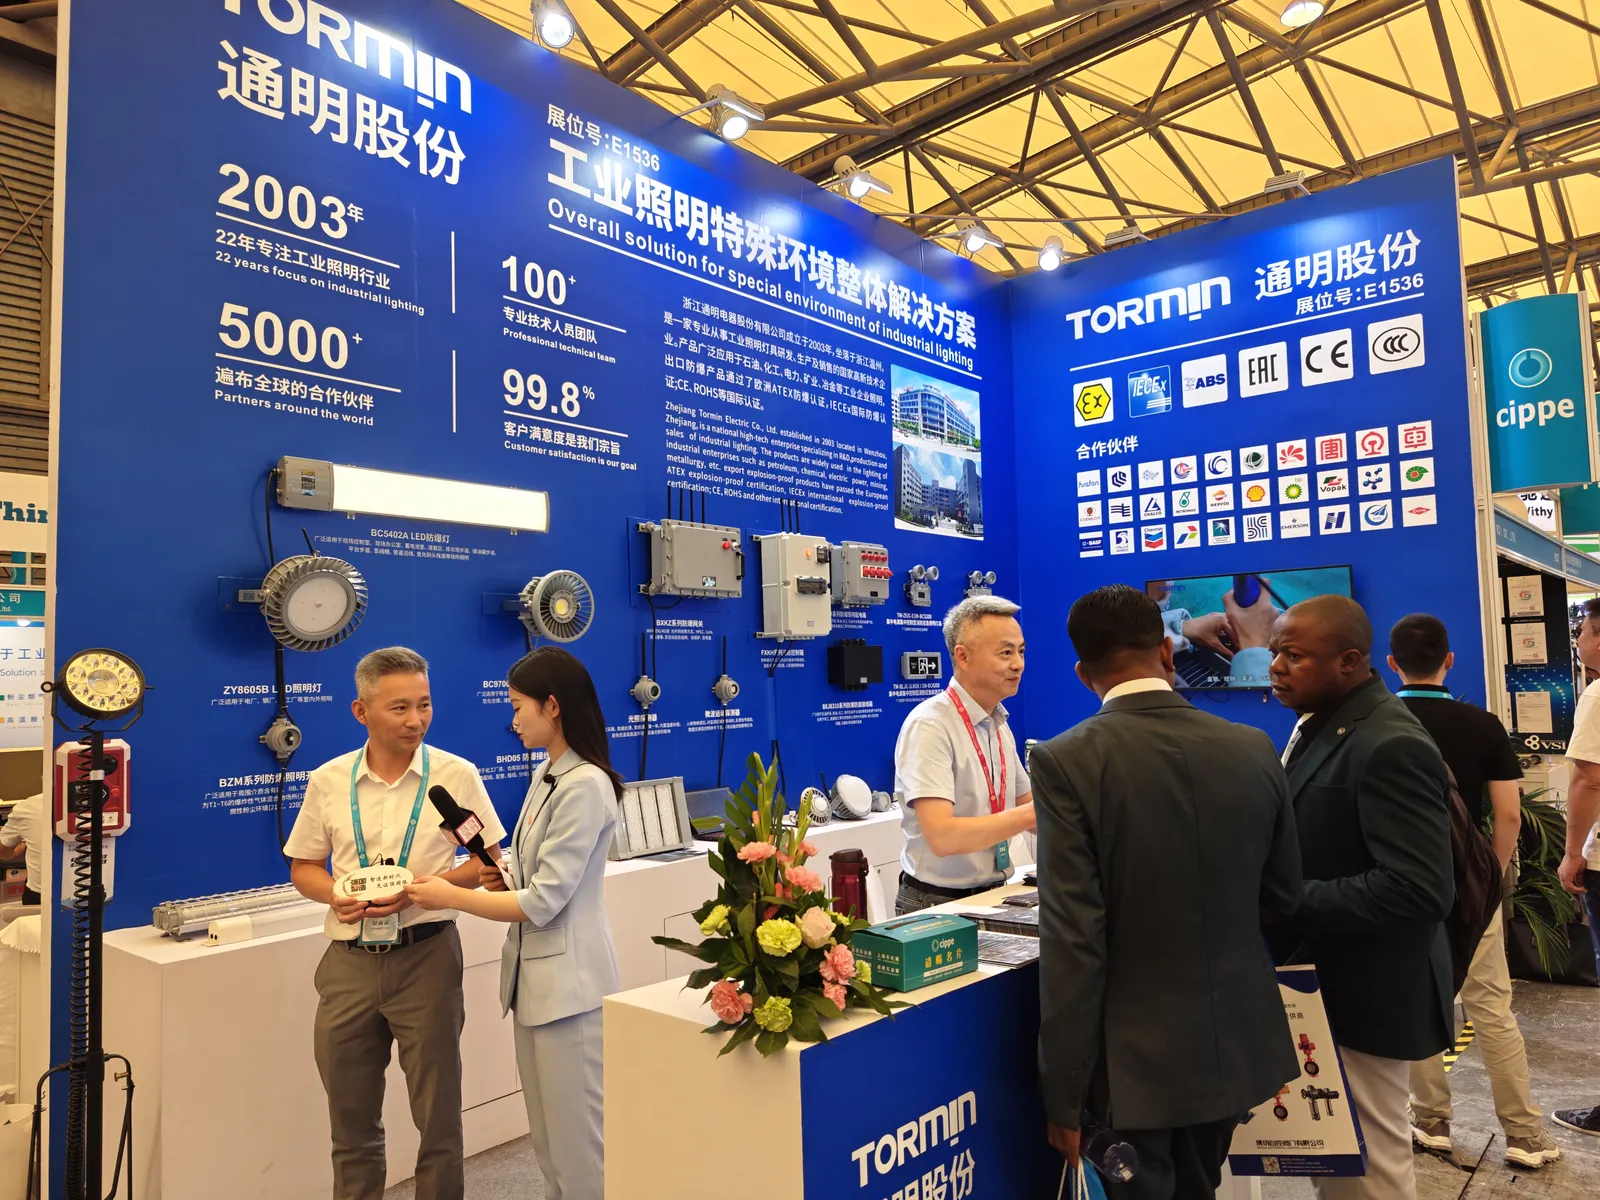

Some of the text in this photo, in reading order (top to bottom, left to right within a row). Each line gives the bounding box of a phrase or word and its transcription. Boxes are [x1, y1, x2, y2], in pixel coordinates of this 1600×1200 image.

[217, 39, 466, 185] 通明股份
[547, 103, 660, 171] 展位号:E1536
[217, 163, 364, 239] 2003年
[215, 229, 390, 290] 22年专注工业照明行业
[547, 138, 977, 349] 工业照明特殊环境整体解决方案
[1254, 228, 1421, 301] 通明股份
[215, 251, 425, 316] 22 years focus on industrial lighting
[548, 198, 973, 371] Overall solution for special environment of industrial lighting
[1296, 272, 1425, 316] 展位号:E1536
[503, 306, 598, 345] 专业技术人员团队
[503, 327, 616, 364] Professional technical team
[1305, 339, 1349, 373] CE
[1132, 376, 1167, 398] IECEx
[1195, 372, 1226, 390] ABS
[1248, 353, 1278, 386] EAC
[215, 366, 374, 411] 遍布全球的合作伙伴
[503, 368, 595, 418] 99.8%
[215, 389, 374, 426] Partners around the world
[1496, 398, 1575, 430] cippe
[504, 421, 620, 456] 客户满意度是我们宗旨
[689, 432, 697, 441] of
[699, 421, 705, 431] is
[814, 435, 820, 443] in
[504, 440, 637, 471] Customer satisfaction is our goal
[1076, 435, 1139, 461] 合作伙伴
[1319, 484, 1347, 494] Vopak
[371, 528, 450, 543] BC5402A LED防爆灯
[223, 683, 322, 695] ZY8605B LD照明灯
[496, 754, 521, 763] BHD05
